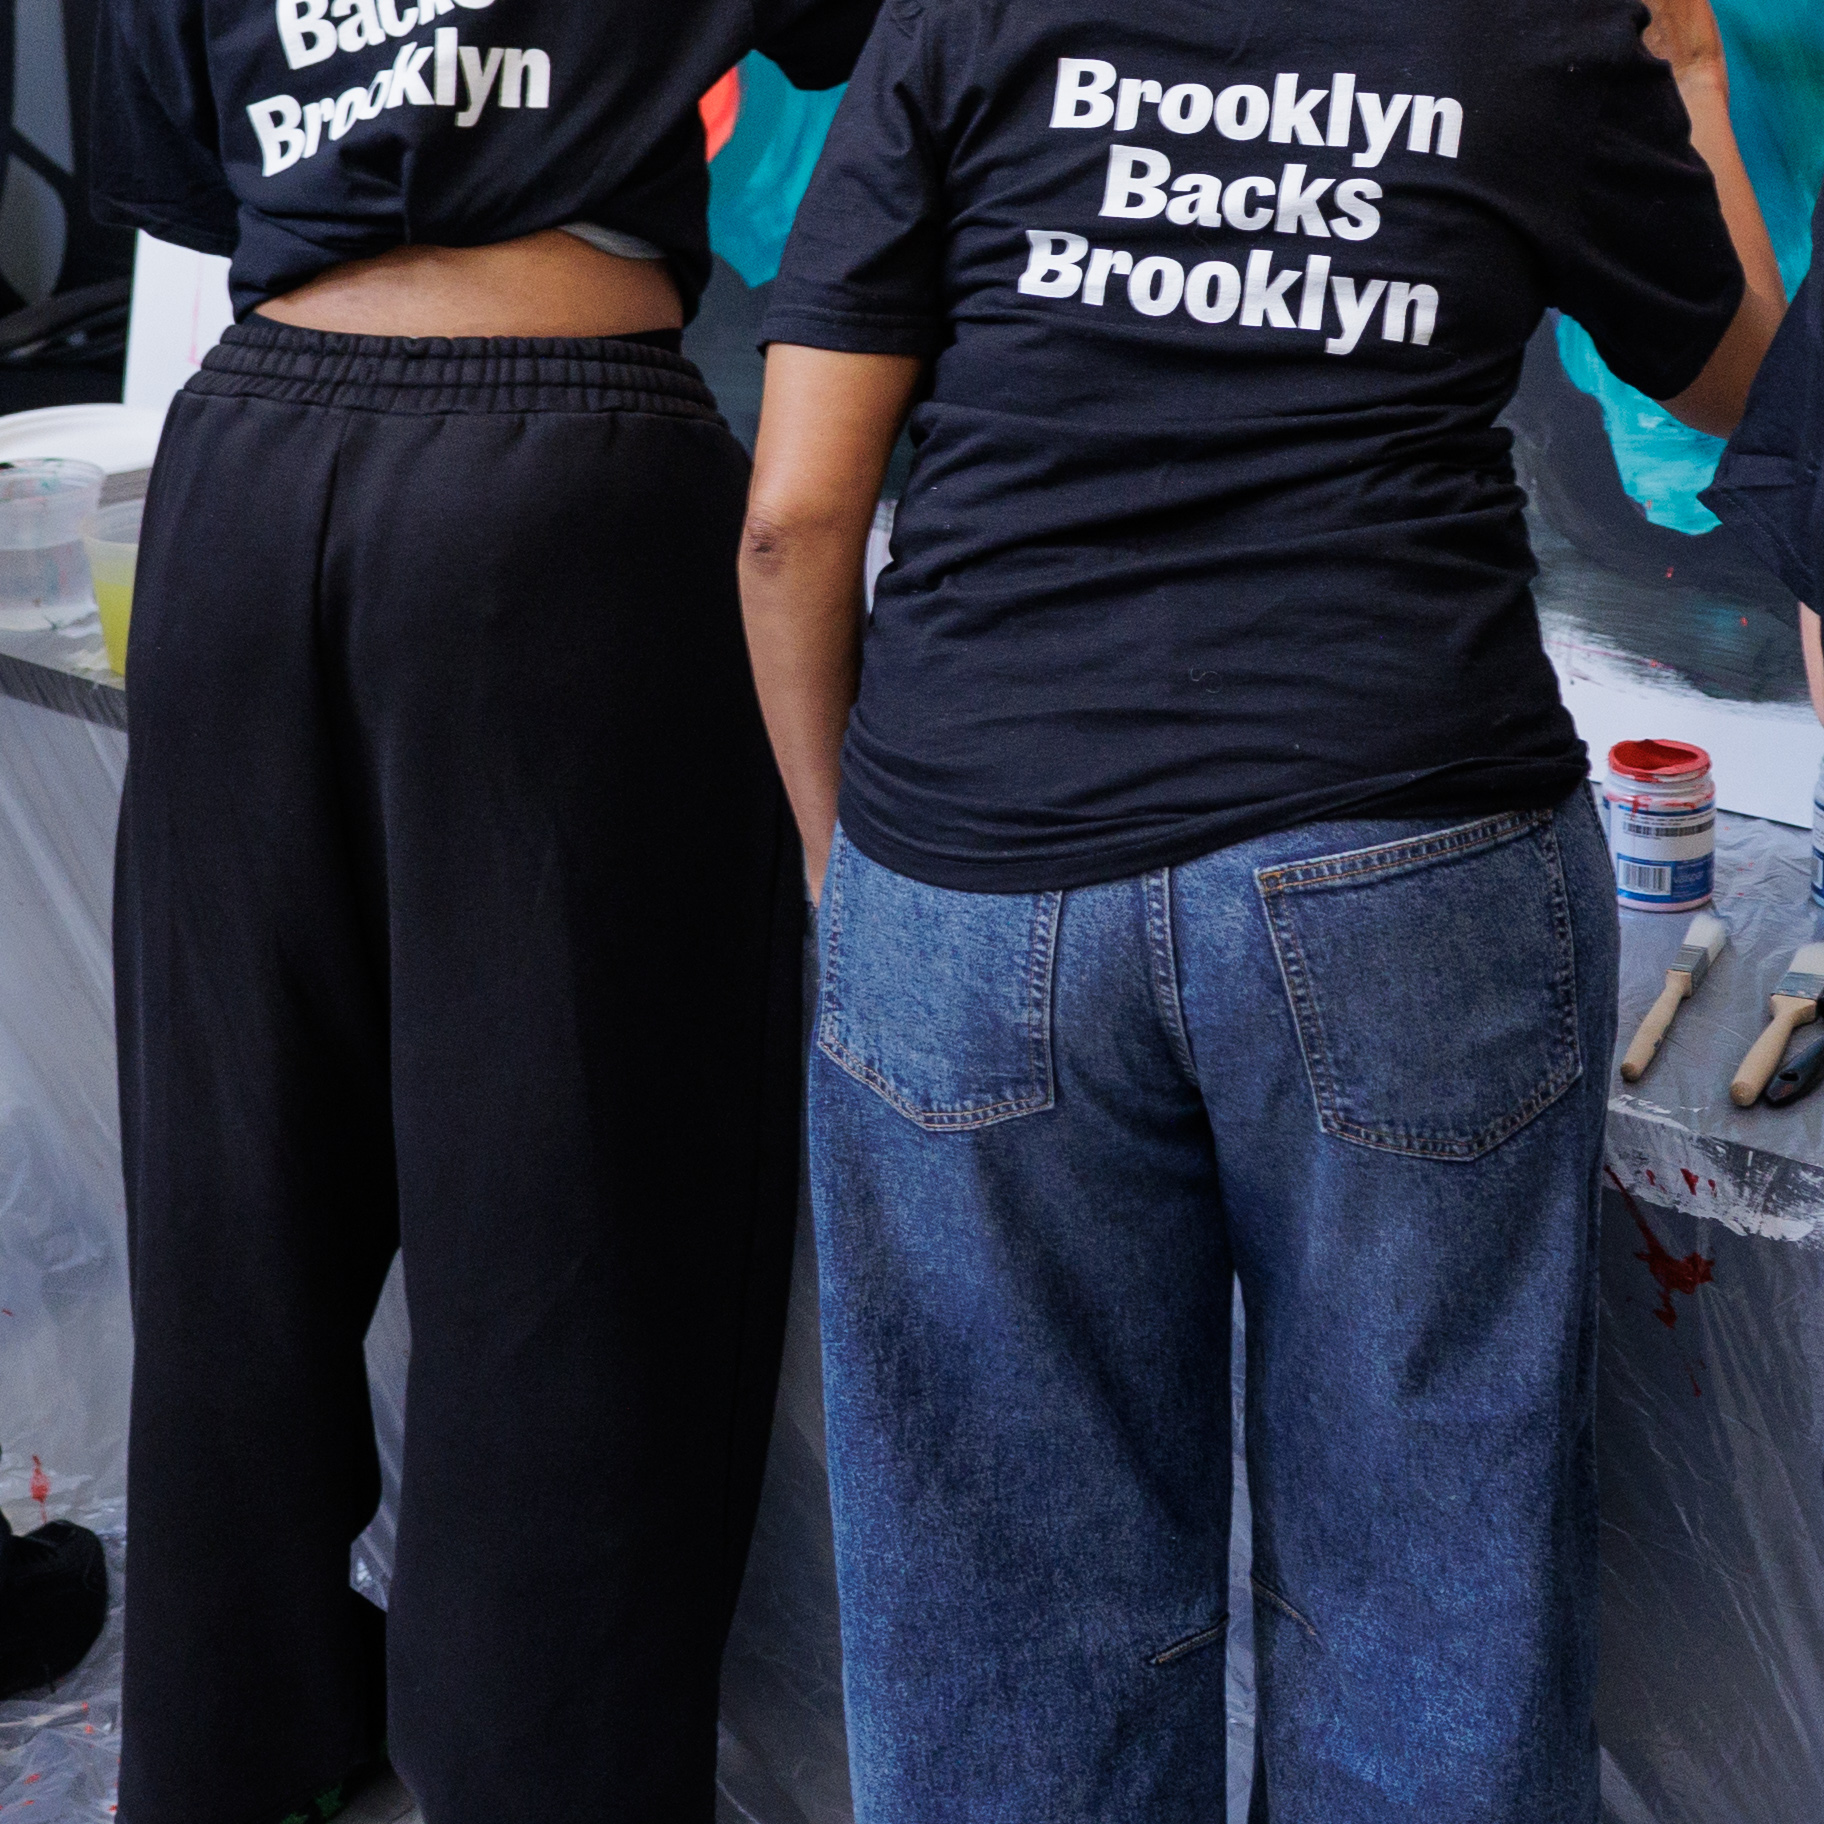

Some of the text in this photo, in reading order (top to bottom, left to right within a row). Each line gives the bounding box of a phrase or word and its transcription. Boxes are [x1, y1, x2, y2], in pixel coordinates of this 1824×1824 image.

[247, 27, 550, 177] Brooklyn
[1049, 58, 1463, 168] Brooklyn
[1099, 144, 1382, 241] Backs
[1018, 230, 1439, 355] Brooklyn
